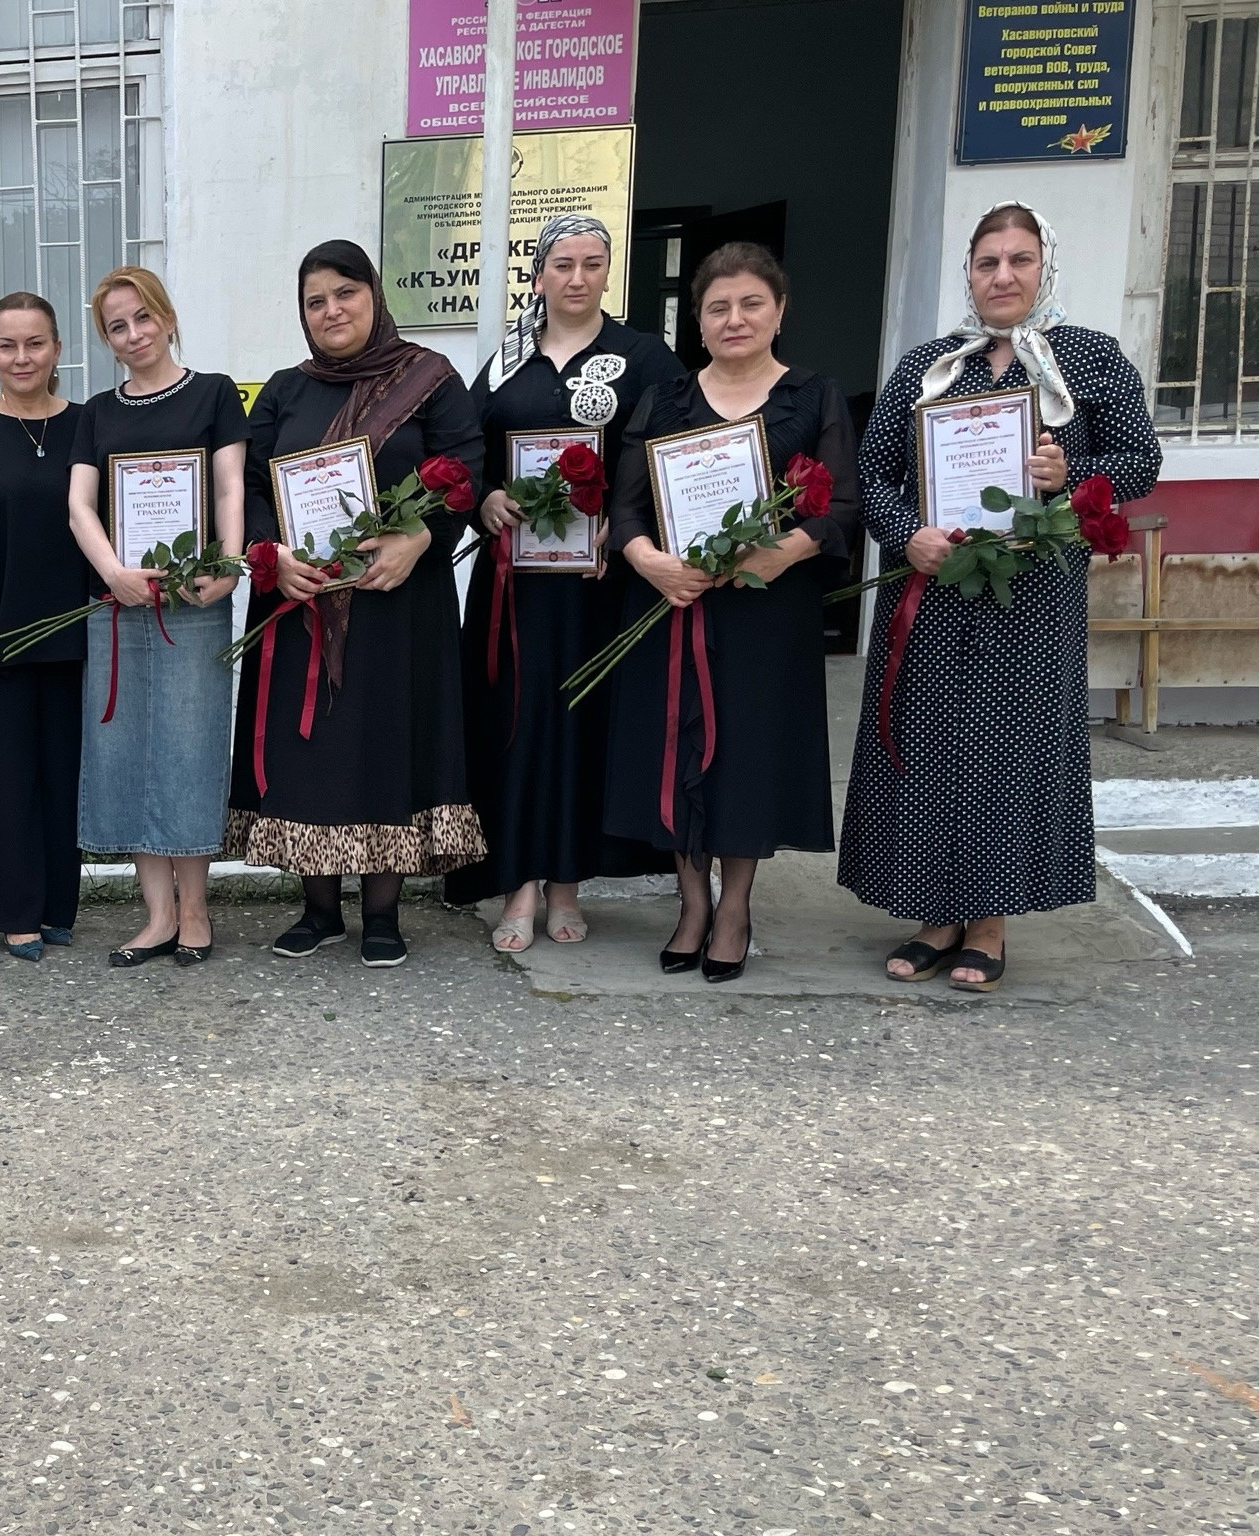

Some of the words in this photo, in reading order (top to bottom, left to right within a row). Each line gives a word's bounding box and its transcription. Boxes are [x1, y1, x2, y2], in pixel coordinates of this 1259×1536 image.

[451, 13, 523, 26] РОССИЯ
[525, 8, 592, 20] ФЕДЕРАЦИЯ
[978, 5, 1037, 18] Ветеранов
[1041, 2, 1078, 15] войны
[1081, 4, 1089, 13] и
[1092, 1, 1124, 14] труда
[529, 19, 586, 32] ДАГЕСТАН
[1001, 25, 1099, 41] Хасавюртовский
[545, 34, 623, 60] ГОРОДСКОЕ
[1001, 44, 1061, 60] городской
[1063, 43, 1097, 56] Совет
[984, 64, 1043, 78] ветеранов
[1046, 62, 1071, 74] ВОВ,
[1075, 61, 1110, 74] труда,
[435, 71, 519, 96] УПРАВЛЕ
[523, 66, 604, 90] ИНВАЛИДОВ
[994, 80, 1074, 94] вооруженных
[1077, 78, 1099, 90] сил
[978, 101, 986, 111] и
[989, 95, 1112, 112] правоохранительных
[516, 106, 618, 121] ИНВАЛИДОВ
[1021, 114, 1067, 128] органов
[403, 193, 472, 204] АДМИНИСТРАЦИЯ
[550, 185, 608, 194] ОБРАЗОВАНИЯ
[417, 210, 481, 220] МУНИЦИПАЛЬНО
[540, 204, 592, 214] УЧРЕЖДЕНИЕ
[423, 202, 476, 211] ГОРОДСКОГО
[511, 197, 537, 206] ГОРОД
[434, 219, 481, 228] ОБЪЕДИНЕН
[945, 447, 1007, 462] ПОЧЕТНАЯ
[951, 456, 1005, 469] ГРАМОТА
[681, 476, 740, 495] ПОЧЕТНАЯ
[300, 495, 338, 509] ПОЧЕТН
[687, 486, 739, 502] ГРАМОТА
[132, 500, 181, 509] ПОЧЕТНАЯ
[137, 508, 179, 516] ГРАМОТА
[306, 504, 341, 515] ГРАМО
